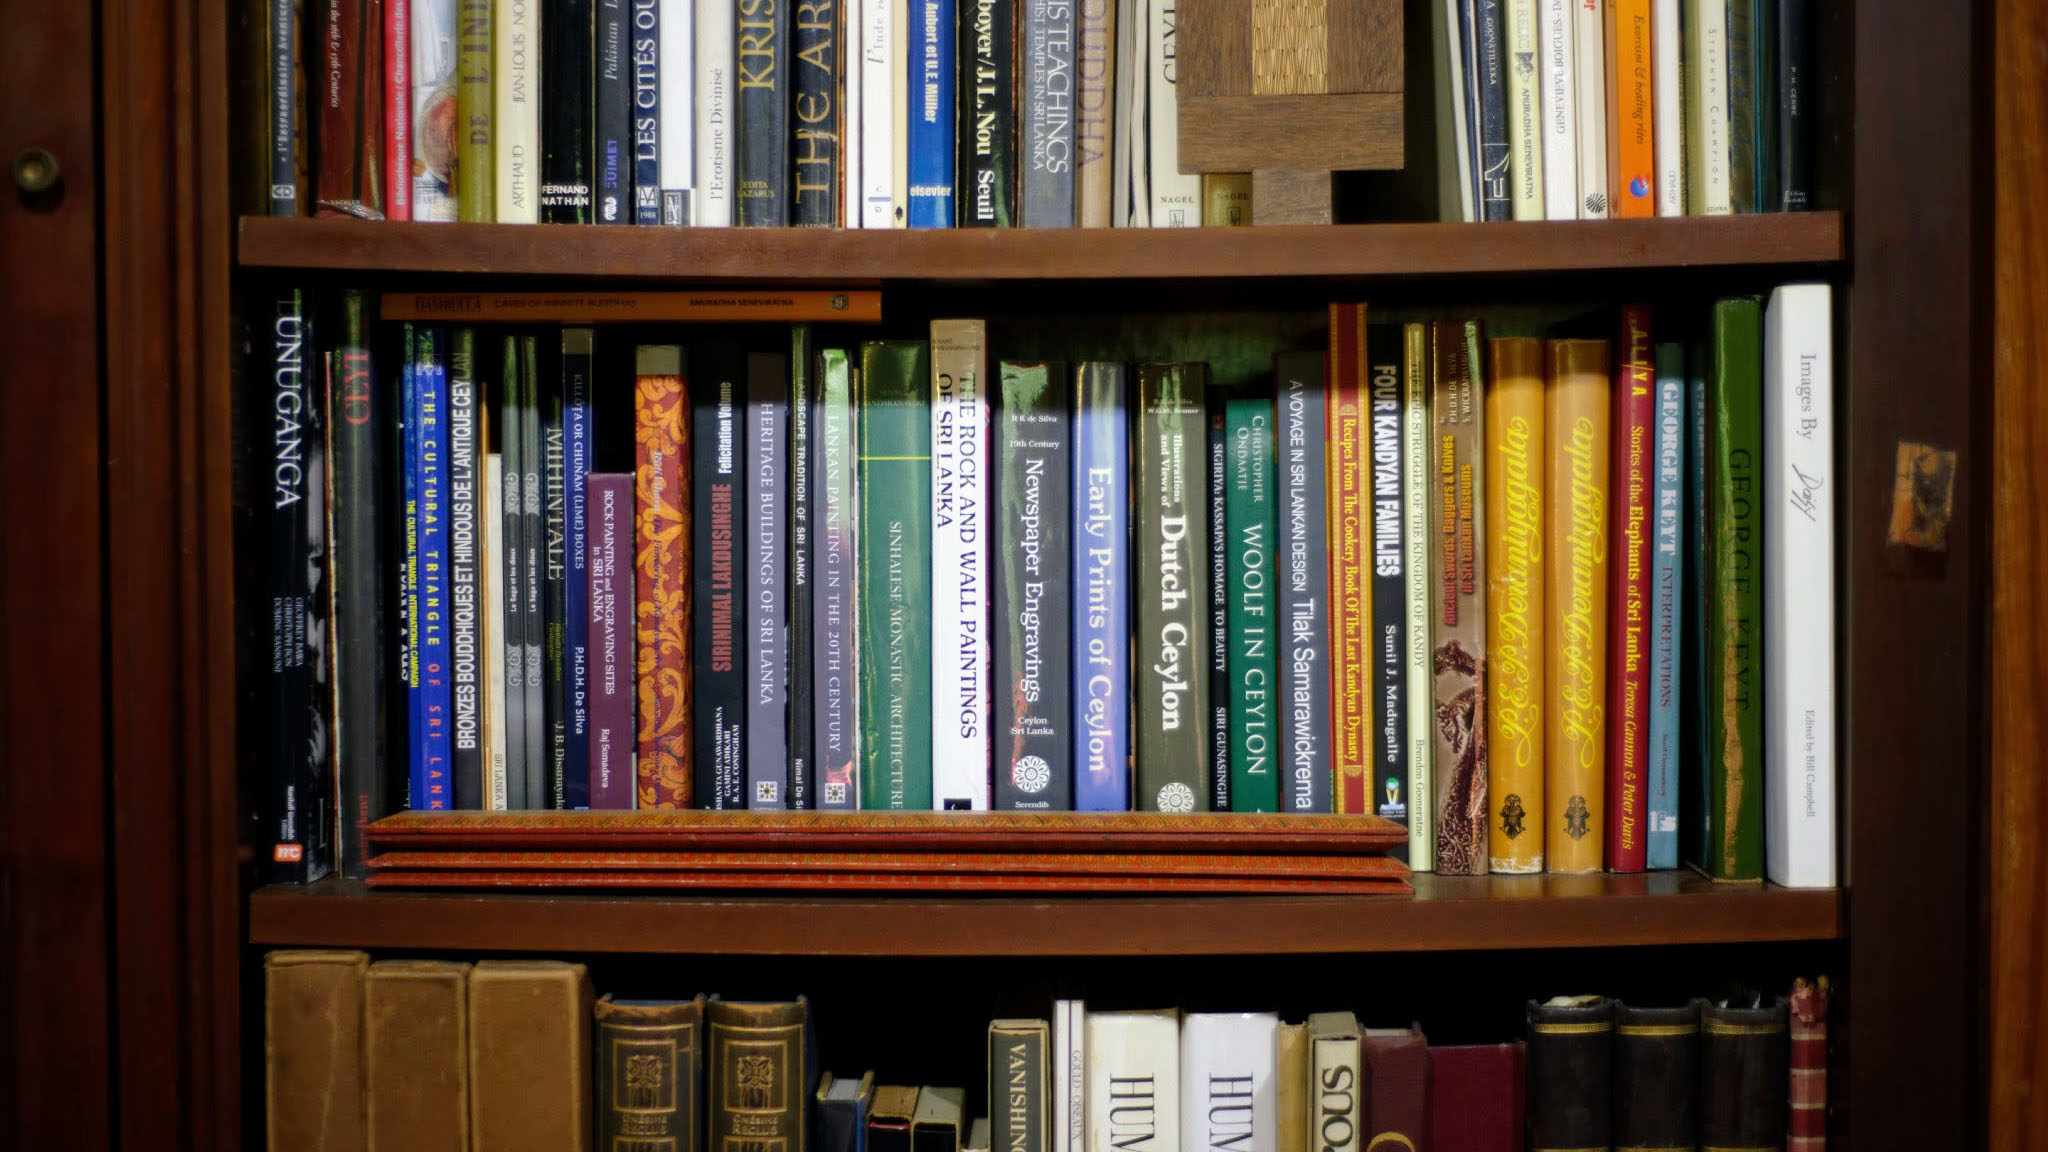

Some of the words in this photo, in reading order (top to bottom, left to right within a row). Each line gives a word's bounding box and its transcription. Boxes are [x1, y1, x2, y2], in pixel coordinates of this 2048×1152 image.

[926, 3, 939, 43] Aubert
[1553, 18, 1564, 67] BOIGUES
[1634, 15, 1646, 64] Exorcism
[512, 33, 526, 104] JEAN-LOUIS
[604, 22, 618, 80] Pakistan
[926, 45, 938, 58] et
[926, 60, 938, 82] U.E.
[1034, 30, 1045, 82] TEMPLES
[1634, 66, 1646, 78] &
[1708, 28, 1717, 94] STEPHEN
[634, 38, 656, 109] CITÉS
[1034, 85, 1044, 99] IN
[926, 84, 940, 122] Müller
[977, 86, 996, 109] L.
[1034, 102, 1044, 121] SRI
[1047, 23, 1068, 173] TEACHINGS
[1522, 88, 1532, 138] ANURADHA
[1554, 73, 1565, 134] GENEVIEVE
[1633, 82, 1646, 120] healing
[470, 113, 489, 146] DE
[636, 118, 656, 162] LES
[977, 111, 996, 156] Nou
[1034, 124, 1045, 170] LANKA
[1636, 122, 1646, 144] rites
[1710, 105, 1719, 184] CHAMPION
[512, 146, 525, 209] ARTHAUD
[542, 186, 589, 194] FERNAND
[910, 186, 952, 196] elsevier
[1524, 139, 1534, 200] SENEVIRATNA
[541, 197, 589, 205] NATHAN
[978, 170, 994, 220] Seuil
[1161, 196, 1194, 204] NAGEL
[960, 372, 976, 418] THE
[1289, 380, 1303, 390] A
[1374, 366, 1396, 411] FOUR
[1411, 363, 1422, 390] THE
[1795, 354, 1816, 412] Images
[718, 382, 732, 418] Volume
[797, 378, 806, 440] LANDSCAPE
[1290, 390, 1304, 446] VOYAGE
[1412, 395, 1422, 418] EPIC
[574, 424, 584, 439] OR
[718, 420, 732, 474] Felicitation
[760, 404, 774, 483] HERITAGE
[828, 416, 840, 480] LANKAN
[1160, 434, 1170, 455] and
[1631, 426, 1644, 466] Stories
[1661, 383, 1678, 483] GEORGE
[1796, 418, 1818, 440] By
[574, 442, 584, 492] CHUNAM
[796, 446, 806, 502] TRADITION
[960, 425, 976, 488] ROCK
[1160, 458, 1170, 492] Views
[1173, 434, 1182, 502] Illustrations
[1214, 443, 1223, 494] SIGIRIYA:
[1290, 449, 1304, 462] IN
[1290, 464, 1305, 485] SRI
[1374, 416, 1398, 496] KANDYAN
[1412, 422, 1422, 489] STRUGGLE
[1630, 469, 1644, 483] of
[546, 428, 564, 580] MIHINTALE
[573, 494, 585, 530] (LIME)
[604, 490, 614, 520] ROCK
[796, 508, 806, 520] OF
[1085, 467, 1112, 537] Early
[1160, 496, 1170, 508] of
[1290, 488, 1305, 540] LANKAN
[1412, 492, 1422, 510] OF
[1630, 484, 1644, 503] the
[712, 484, 732, 591] LAKDUSINGHE
[796, 526, 806, 544] SRI
[828, 487, 840, 563] PAINTING
[960, 496, 976, 543] AND
[1020, 458, 1044, 575] Newspaper
[1214, 498, 1224, 551] KASSAPA'S
[1376, 500, 1400, 576] FAMILIES
[1413, 513, 1423, 538] THE
[1660, 489, 1678, 556] KEYT
[574, 533, 584, 569] BOXES
[594, 546, 602, 555] in
[604, 523, 614, 576] PAINTING
[760, 493, 774, 585] BUILDINGS
[1626, 506, 1644, 580] Elephants
[593, 558, 602, 576] SRI
[796, 550, 806, 585] LANKA
[829, 570, 841, 586] IN
[960, 551, 976, 612] WALL
[1160, 514, 1188, 611] Dutch
[1214, 554, 1224, 605] HOMAGE
[1242, 522, 1265, 616] WOOLF
[1291, 542, 1306, 592] DESIGN
[1414, 542, 1424, 602] KINGDOM
[594, 580, 604, 623] LANKA
[760, 590, 774, 612] OF
[828, 593, 841, 624] THE
[1089, 548, 1112, 628] Prints
[1627, 586, 1642, 597] of
[605, 594, 614, 663] ENGRAVING
[760, 617, 774, 643] SRI
[1215, 610, 1225, 626] TO
[1292, 598, 1316, 643] Tilak
[1414, 605, 1424, 621] OF
[1626, 600, 1642, 622] Sri
[712, 594, 732, 672] SIRINIMAL
[828, 631, 841, 670] 20TH
[1020, 582, 1043, 702] Engravings
[1089, 638, 1112, 665] of
[1216, 628, 1225, 671] BEAUTY
[1244, 628, 1265, 658] IN
[1384, 625, 1397, 663] Sunil
[1414, 625, 1424, 668] KANDY
[1626, 627, 1642, 672] Lanka
[1660, 567, 1673, 708] INTERPRETATIONS
[575, 646, 585, 689] P.H.D.H.
[606, 664, 614, 695] SITES
[760, 650, 774, 704] LANKA
[960, 620, 977, 738] PAINTINGS
[1154, 622, 1188, 731] Ceylon
[1384, 668, 1397, 679] J.
[576, 692, 585, 706] De
[828, 676, 841, 752] CENTURY
[1216, 706, 1226, 728] SIRI
[1625, 681, 1638, 717] Teresa
[576, 708, 586, 734] Silva
[600, 728, 610, 742] Raj
[1084, 674, 1112, 771] Ceylon
[1245, 668, 1266, 774] CEYLON
[1293, 648, 1316, 808] Samarawickrema
[1384, 685, 1398, 762] Madugalle
[1805, 710, 1816, 740] Edited
[494, 753, 503, 768] SRI
[1416, 740, 1426, 778] Brendon
[1624, 720, 1636, 767] Cannon
[1804, 742, 1816, 754] by
[1806, 755, 1816, 771] Bill
[494, 770, 504, 800] LANKA
[600, 744, 610, 788] Somadeva
[795, 758, 804, 784] Nimal
[1216, 731, 1226, 807] GUNASINGHE
[1624, 772, 1636, 781] &
[795, 786, 804, 797] De
[1416, 782, 1426, 837] Gooneratne
[1622, 783, 1635, 814] Peter
[1804, 774, 1816, 817] Campbell
[1622, 816, 1634, 850] Davis
[1072, 1050, 1082, 1088] GOULD
[1072, 1094, 1082, 1140] OISEAUX
